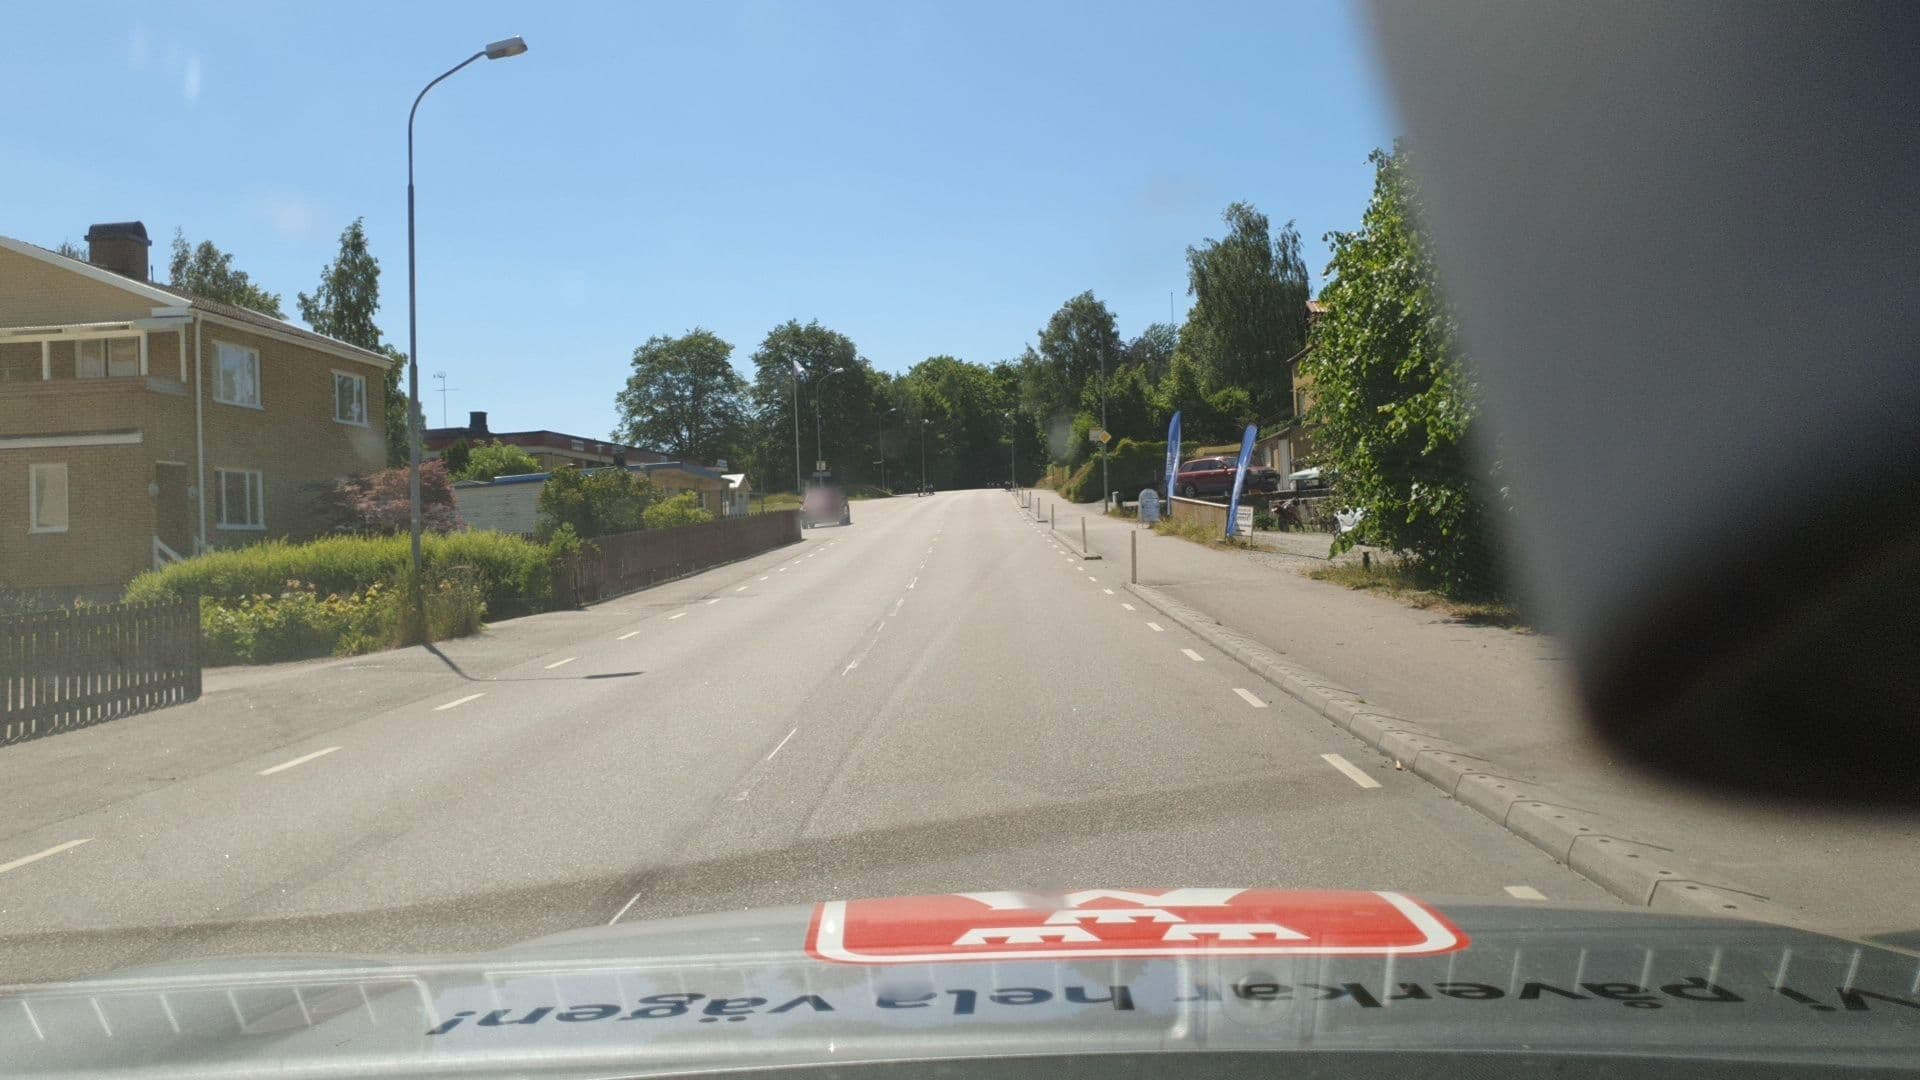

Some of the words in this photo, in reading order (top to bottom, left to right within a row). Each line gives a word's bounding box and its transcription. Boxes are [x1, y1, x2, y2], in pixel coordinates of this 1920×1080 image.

[876, 985, 1135, 1015] hela
[1174, 976, 1745, 1010] påverkar
[1769, 985, 1920, 1012] Vi
[425, 992, 834, 1035] vägen!
